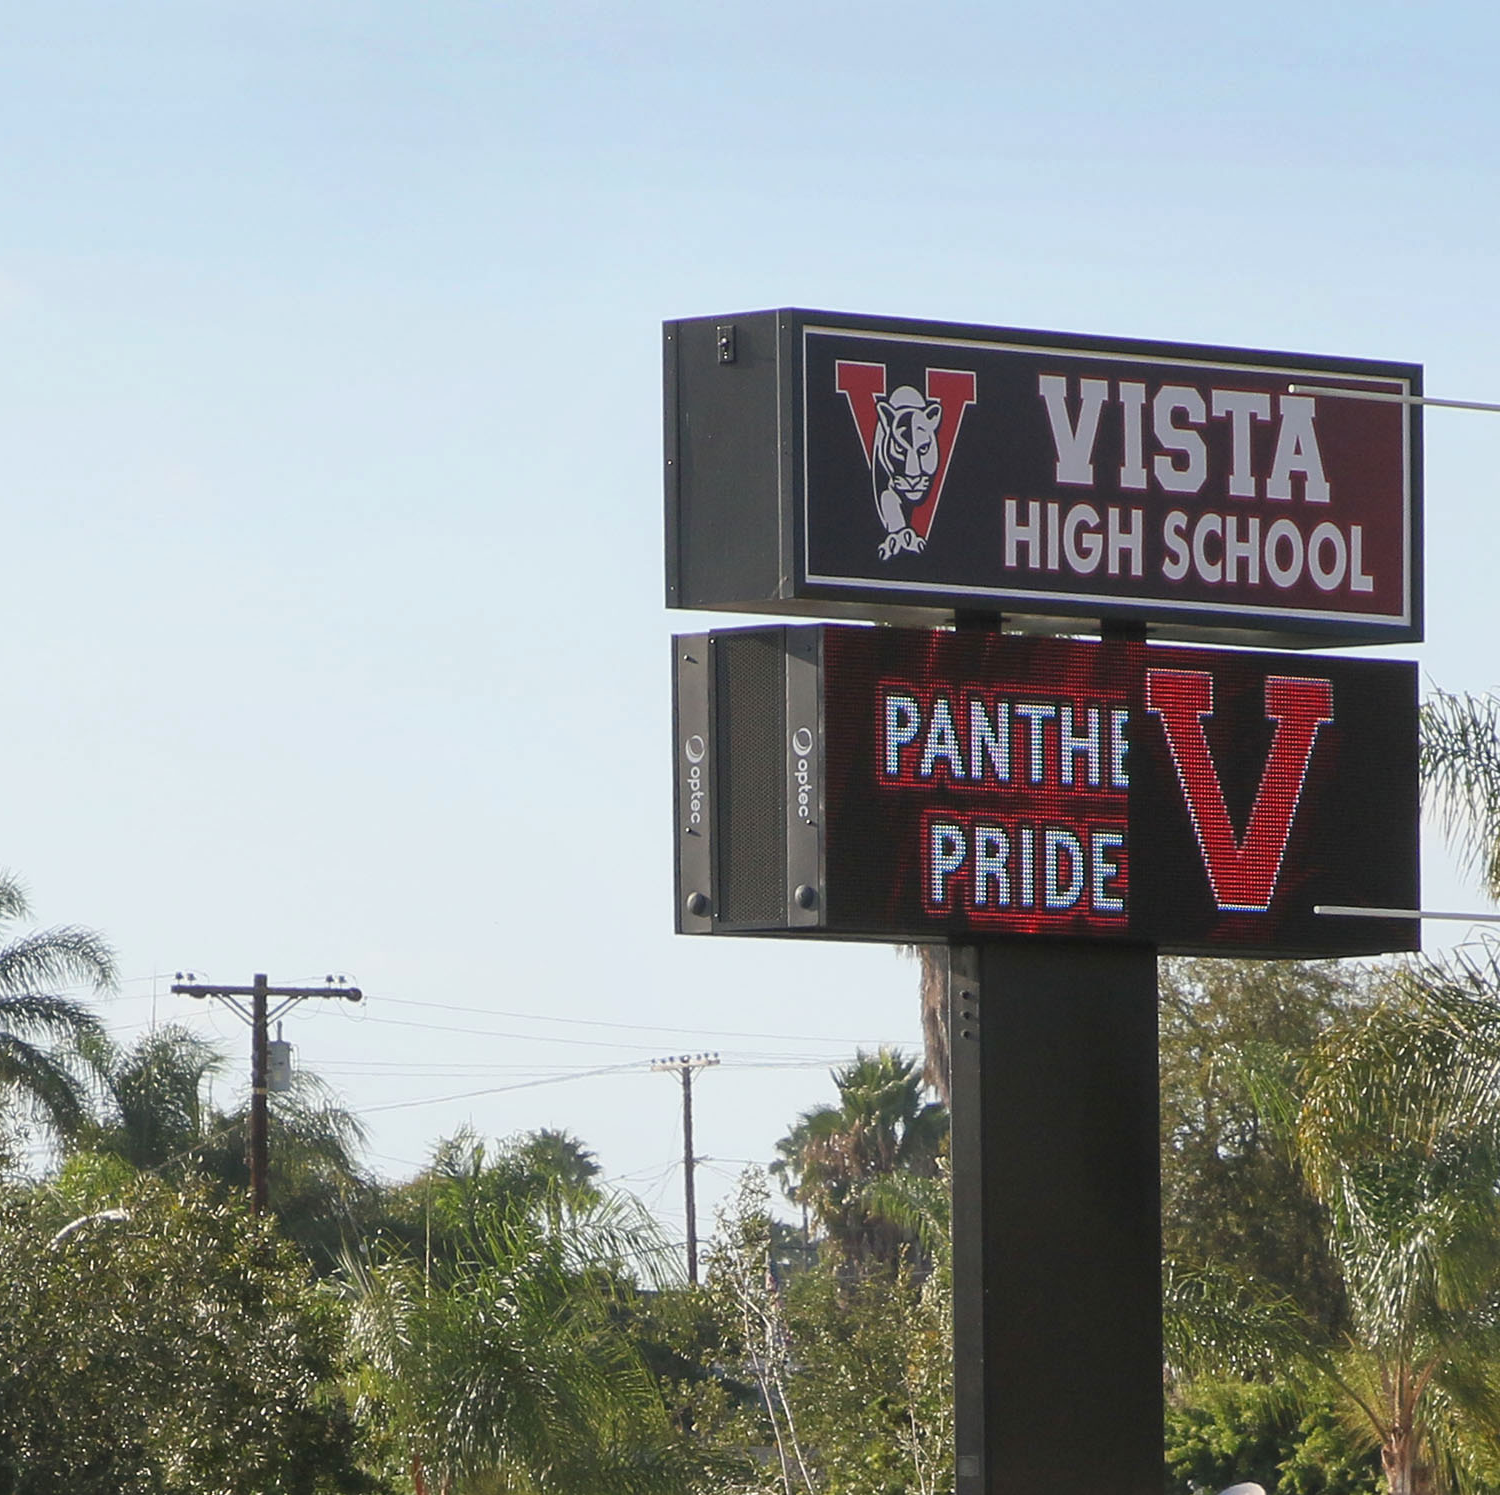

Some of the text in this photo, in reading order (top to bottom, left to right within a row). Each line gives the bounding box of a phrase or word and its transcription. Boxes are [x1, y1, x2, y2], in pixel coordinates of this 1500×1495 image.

[1038, 374, 1331, 503] VISTA
[1005, 499, 1375, 592] HIGH SCHOOL
[885, 695, 1130, 787] PANTHE
[687, 766, 705, 824] optec
[795, 758, 812, 818] optec
[1146, 668, 1334, 912] V
[931, 823, 1125, 911] PRIDE
